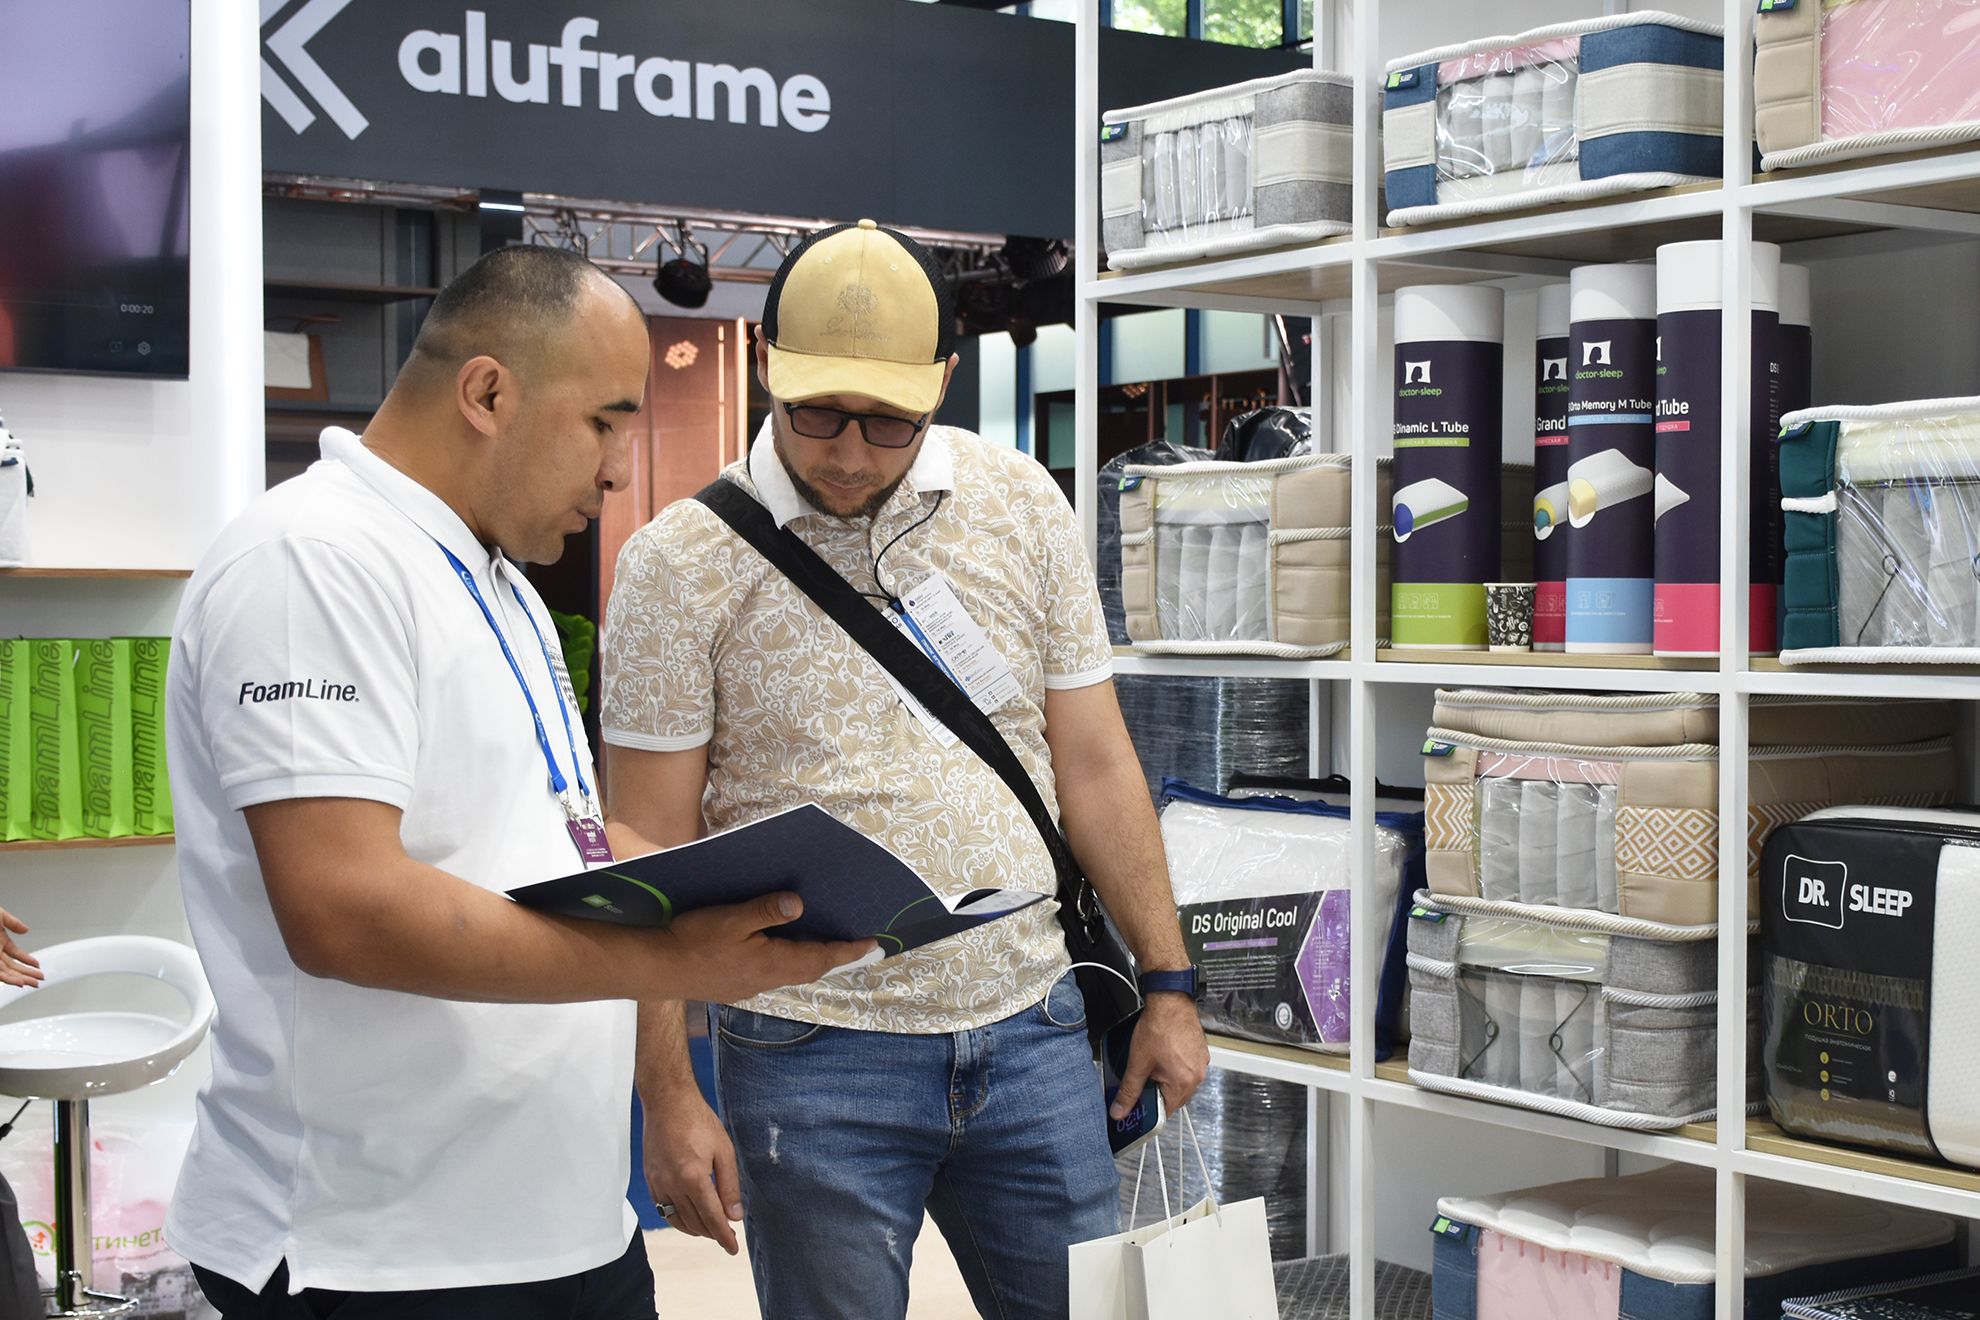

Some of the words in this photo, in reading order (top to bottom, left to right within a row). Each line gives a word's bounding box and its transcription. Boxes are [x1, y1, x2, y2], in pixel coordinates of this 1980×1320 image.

[398, 10, 831, 133] aluframe
[120, 303, 154, 314] 0:00:20
[1581, 400, 1616, 412] Memory
[1618, 399, 1627, 409] M
[1629, 399, 1652, 409] Tube
[1661, 398, 1689, 416] Tube
[1432, 421, 1438, 433] L
[1441, 421, 1469, 433] Tube
[1536, 415, 1566, 431] Grand
[81, 640, 115, 838] FoamLine
[1798, 877, 1830, 907] DR.
[1848, 883, 1913, 917] SLEEP
[1191, 913, 1211, 934] DS
[1213, 908, 1264, 936] Original
[1266, 905, 1298, 928] Cool
[1804, 1000, 1874, 1035] ORTO
